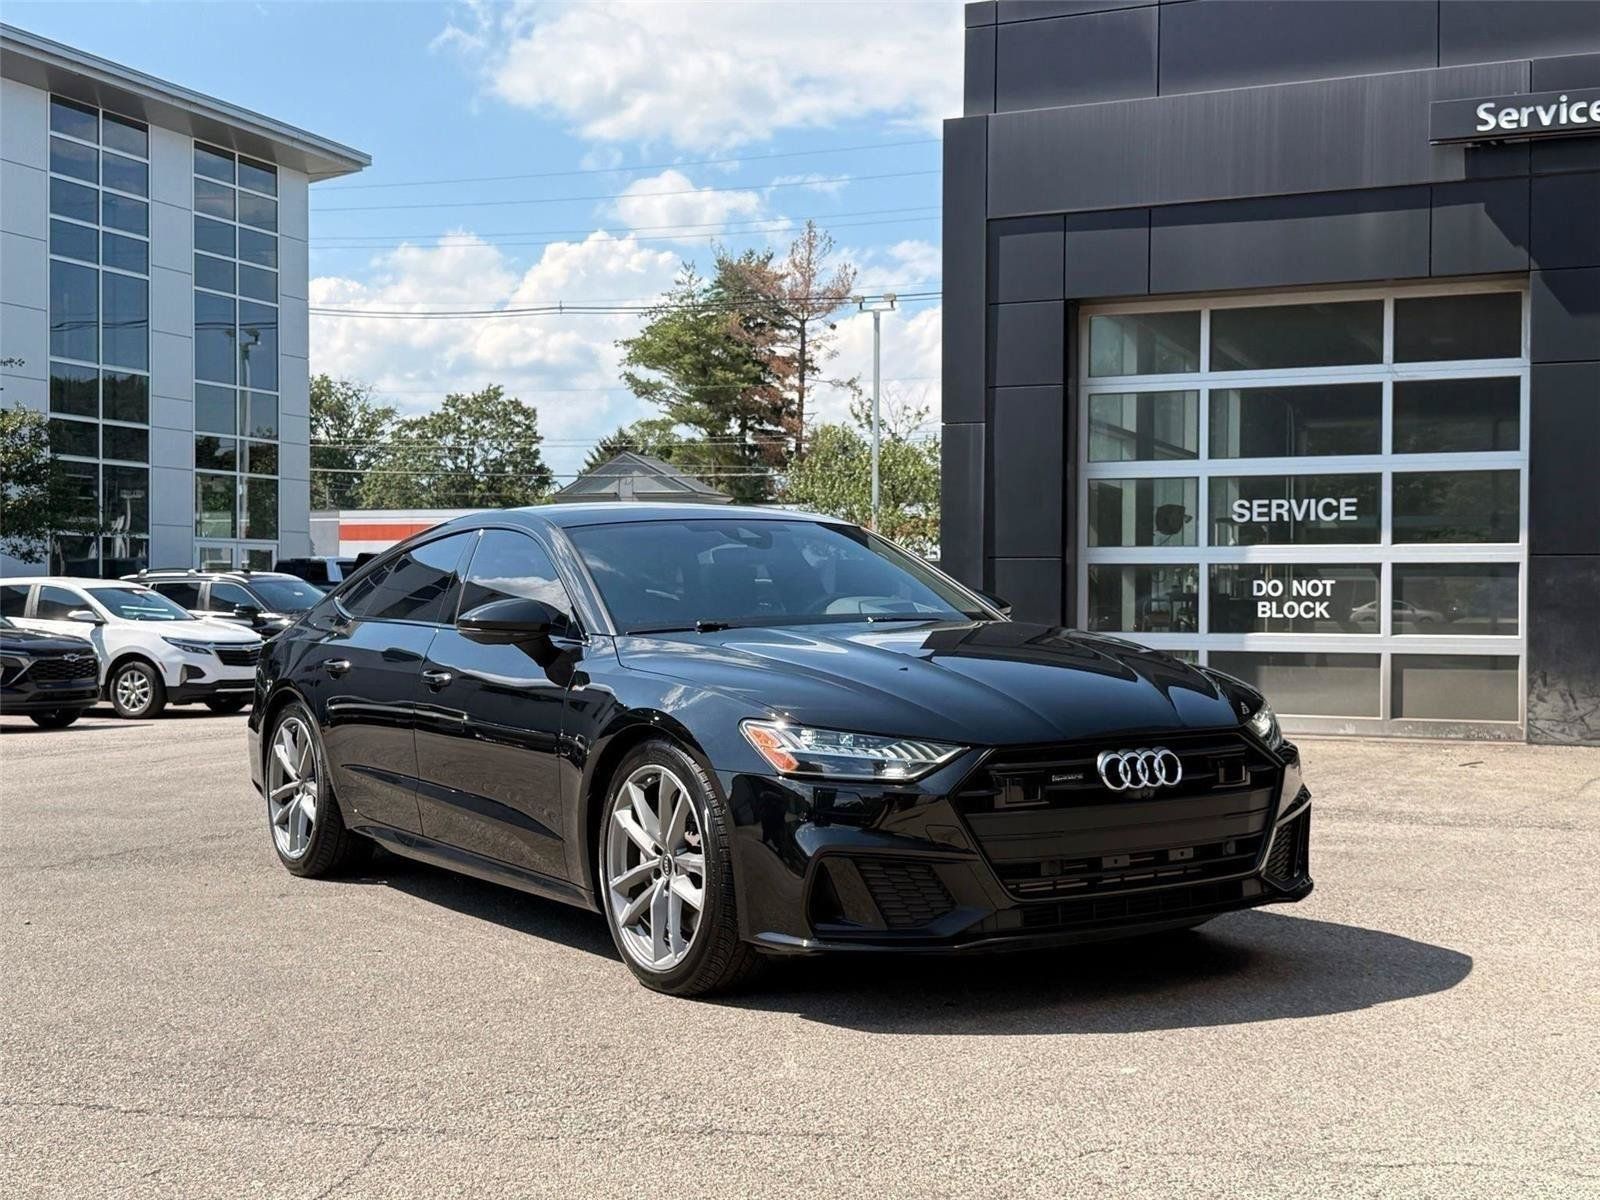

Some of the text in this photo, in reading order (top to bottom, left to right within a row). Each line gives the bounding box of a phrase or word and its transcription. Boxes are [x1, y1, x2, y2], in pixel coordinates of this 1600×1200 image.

[1231, 497, 1358, 523] SERVICE
[1252, 579, 1336, 597] DO NOT
[1257, 601, 1331, 619] BLOCK
